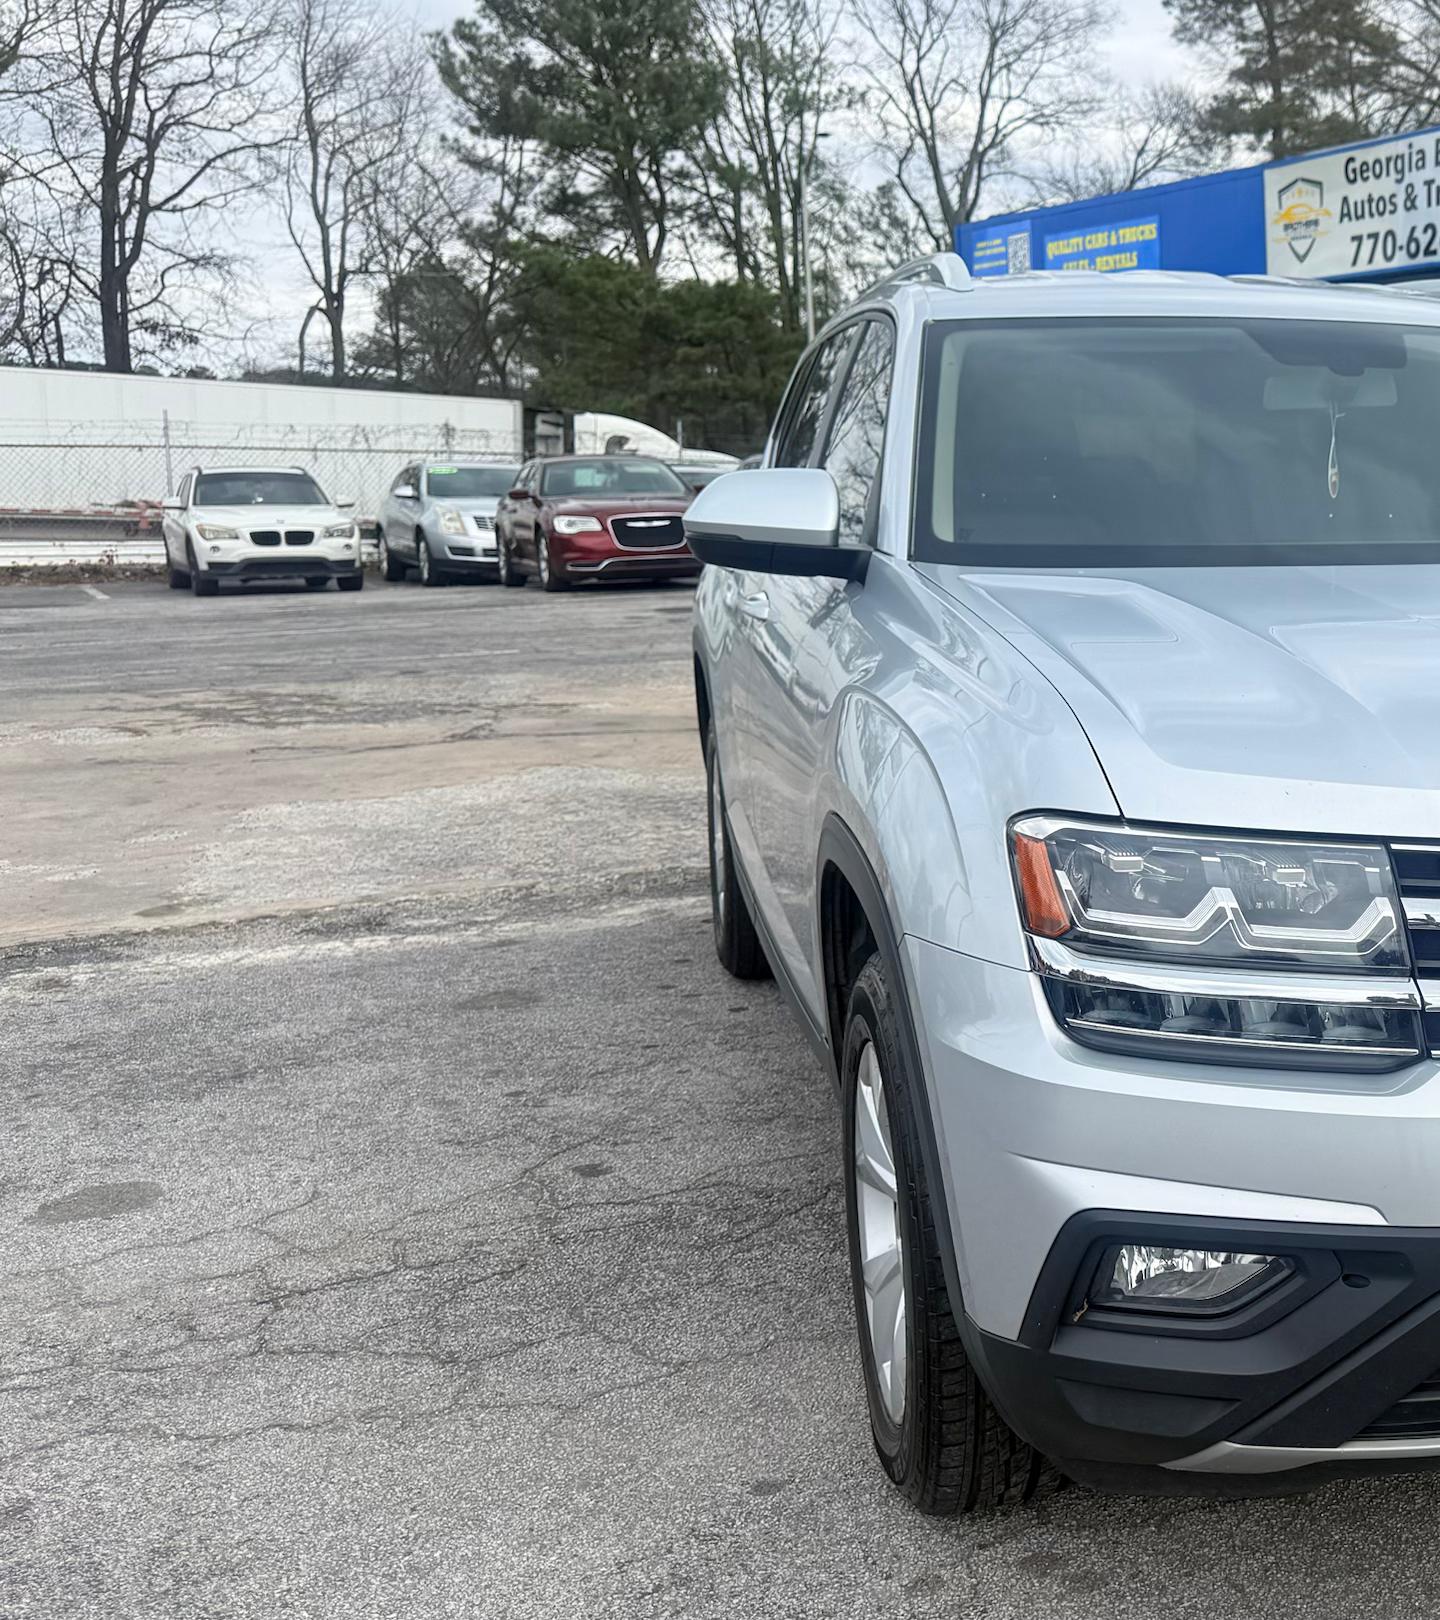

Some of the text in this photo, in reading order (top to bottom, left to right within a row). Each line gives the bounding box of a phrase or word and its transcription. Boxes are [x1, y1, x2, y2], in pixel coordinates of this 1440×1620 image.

[1344, 142, 1426, 184] Georgia
[1339, 194, 1397, 224] Autos
[1403, 183, 1418, 210] &
[1046, 237, 1083, 260] QUALITY
[1085, 232, 1108, 250] CARS
[1119, 223, 1157, 244] TRUCKS
